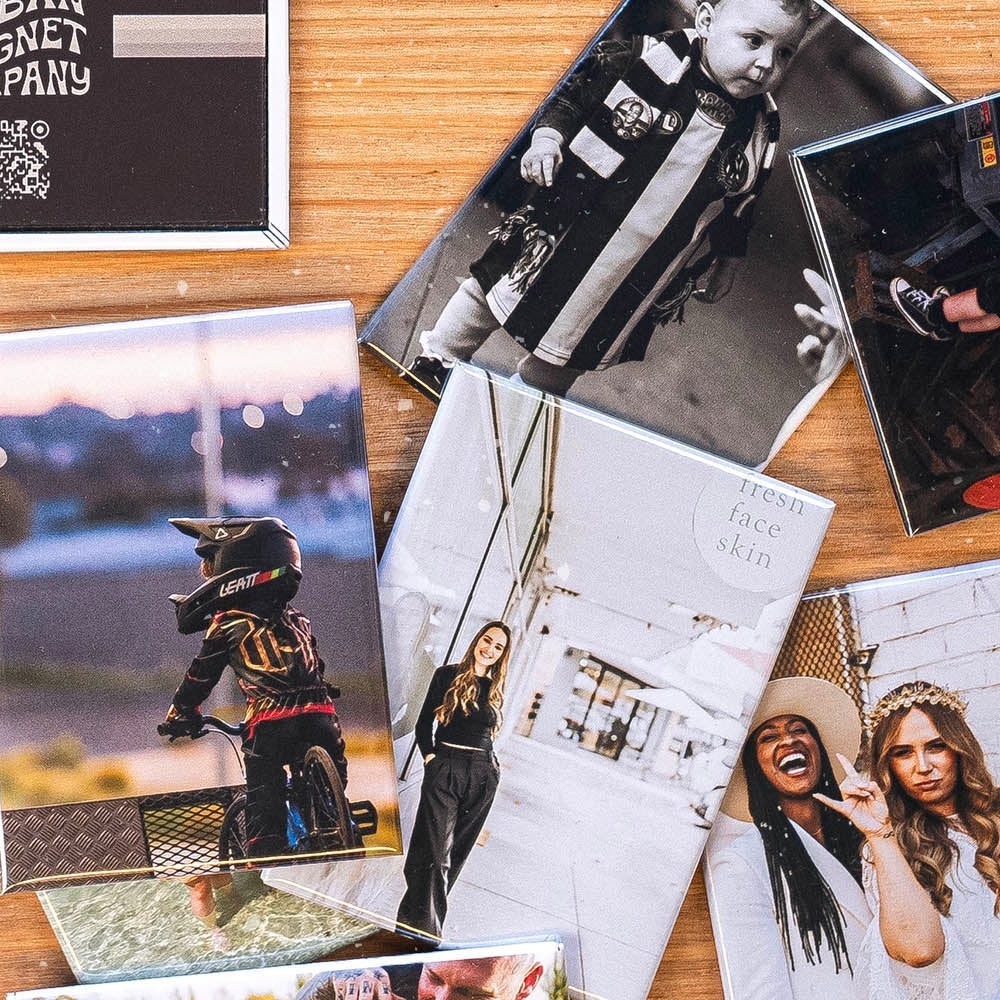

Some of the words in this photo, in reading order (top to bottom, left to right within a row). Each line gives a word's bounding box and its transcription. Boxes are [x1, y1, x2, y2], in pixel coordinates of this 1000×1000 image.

[727, 501, 781, 539] face
[716, 533, 771, 570] skin
[219, 571, 261, 598] LEATT
